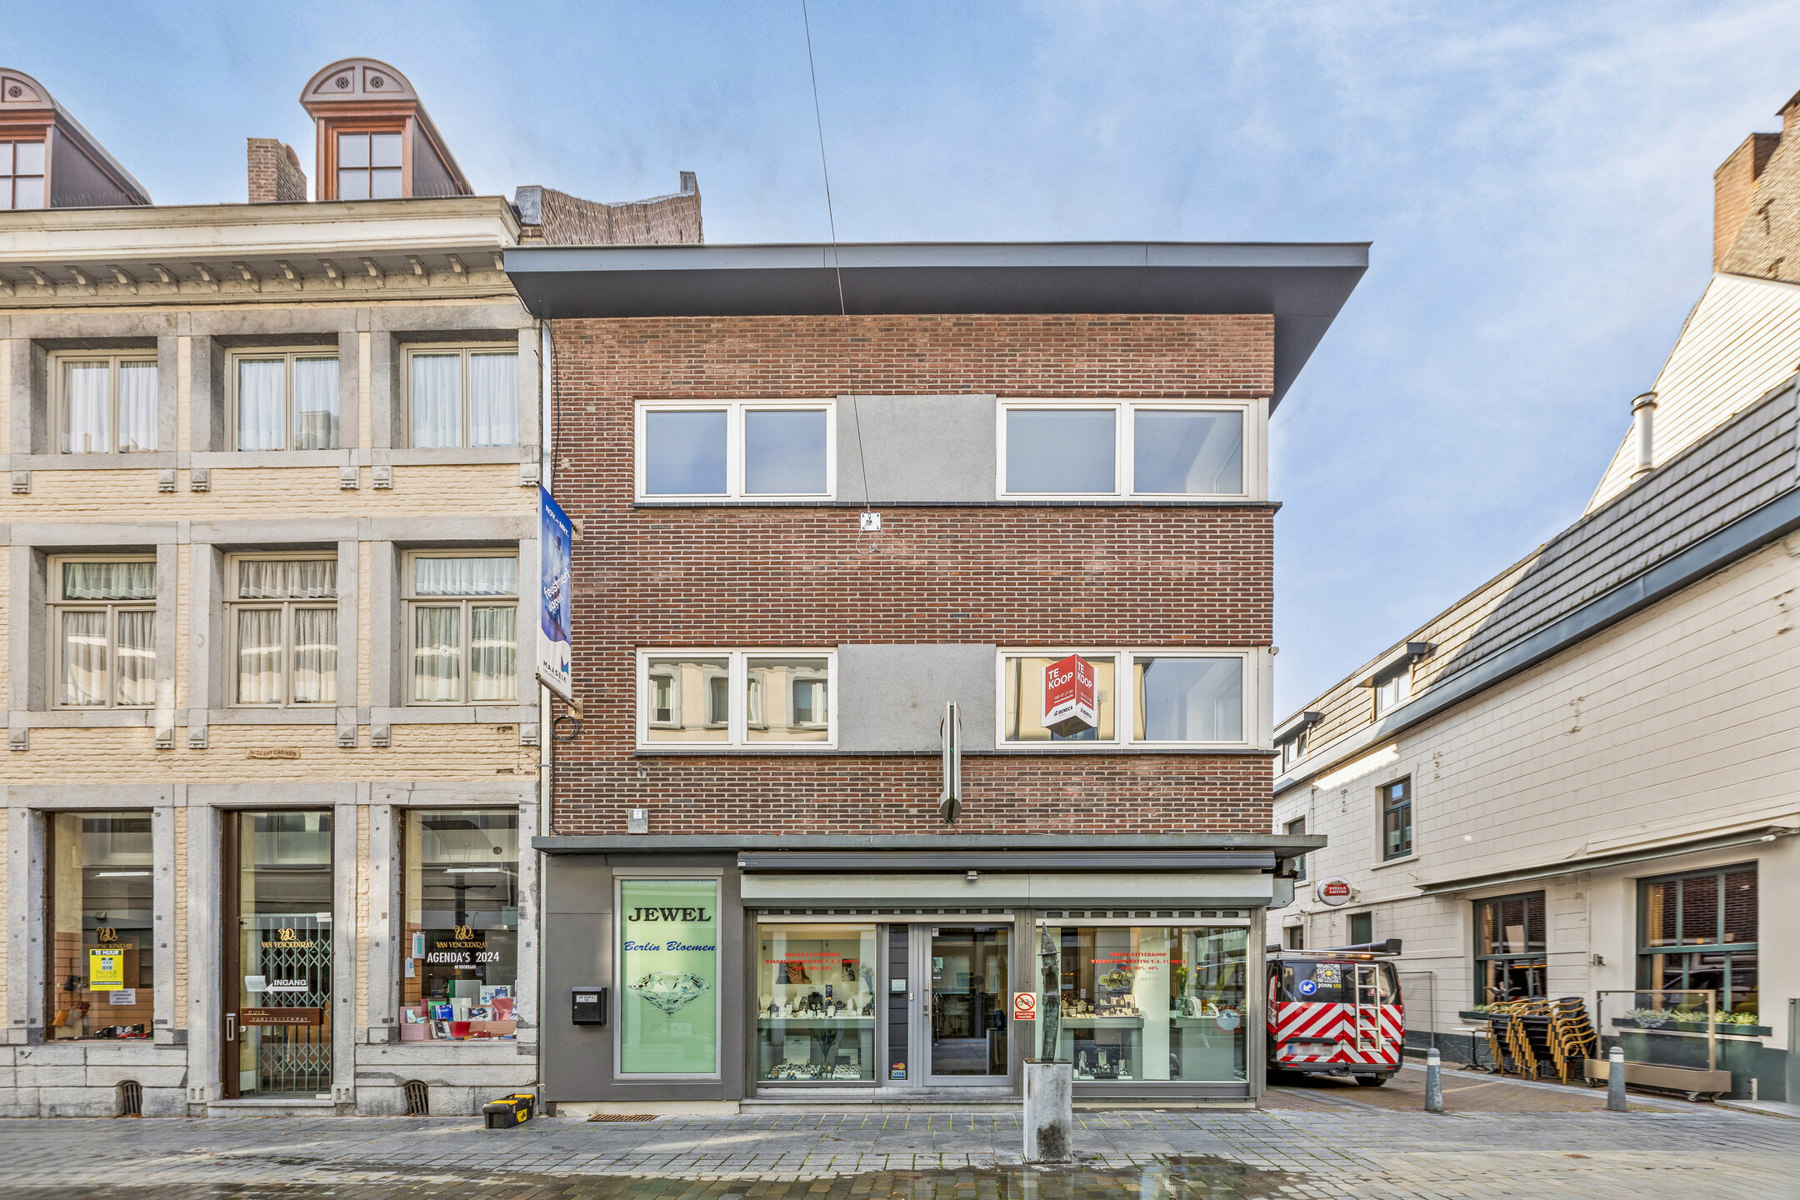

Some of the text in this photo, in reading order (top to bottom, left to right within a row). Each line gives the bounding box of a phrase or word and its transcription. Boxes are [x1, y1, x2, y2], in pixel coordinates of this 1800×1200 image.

[543, 660, 567, 683] MAASEIK
[1048, 668, 1059, 680] TE
[1077, 662, 1084, 674] TE
[1048, 672, 1073, 690] KOOP
[1077, 672, 1092, 688] KOOP
[1059, 706, 1073, 715] BENECA
[628, 907, 712, 922] JEWEL
[273, 941, 314, 949] VENCKENRAY
[435, 941, 489, 949] VAN VENCKENRAY
[623, 940, 716, 952] Berlin Bloemen
[426, 951, 500, 963] AGENDA'S 2024
